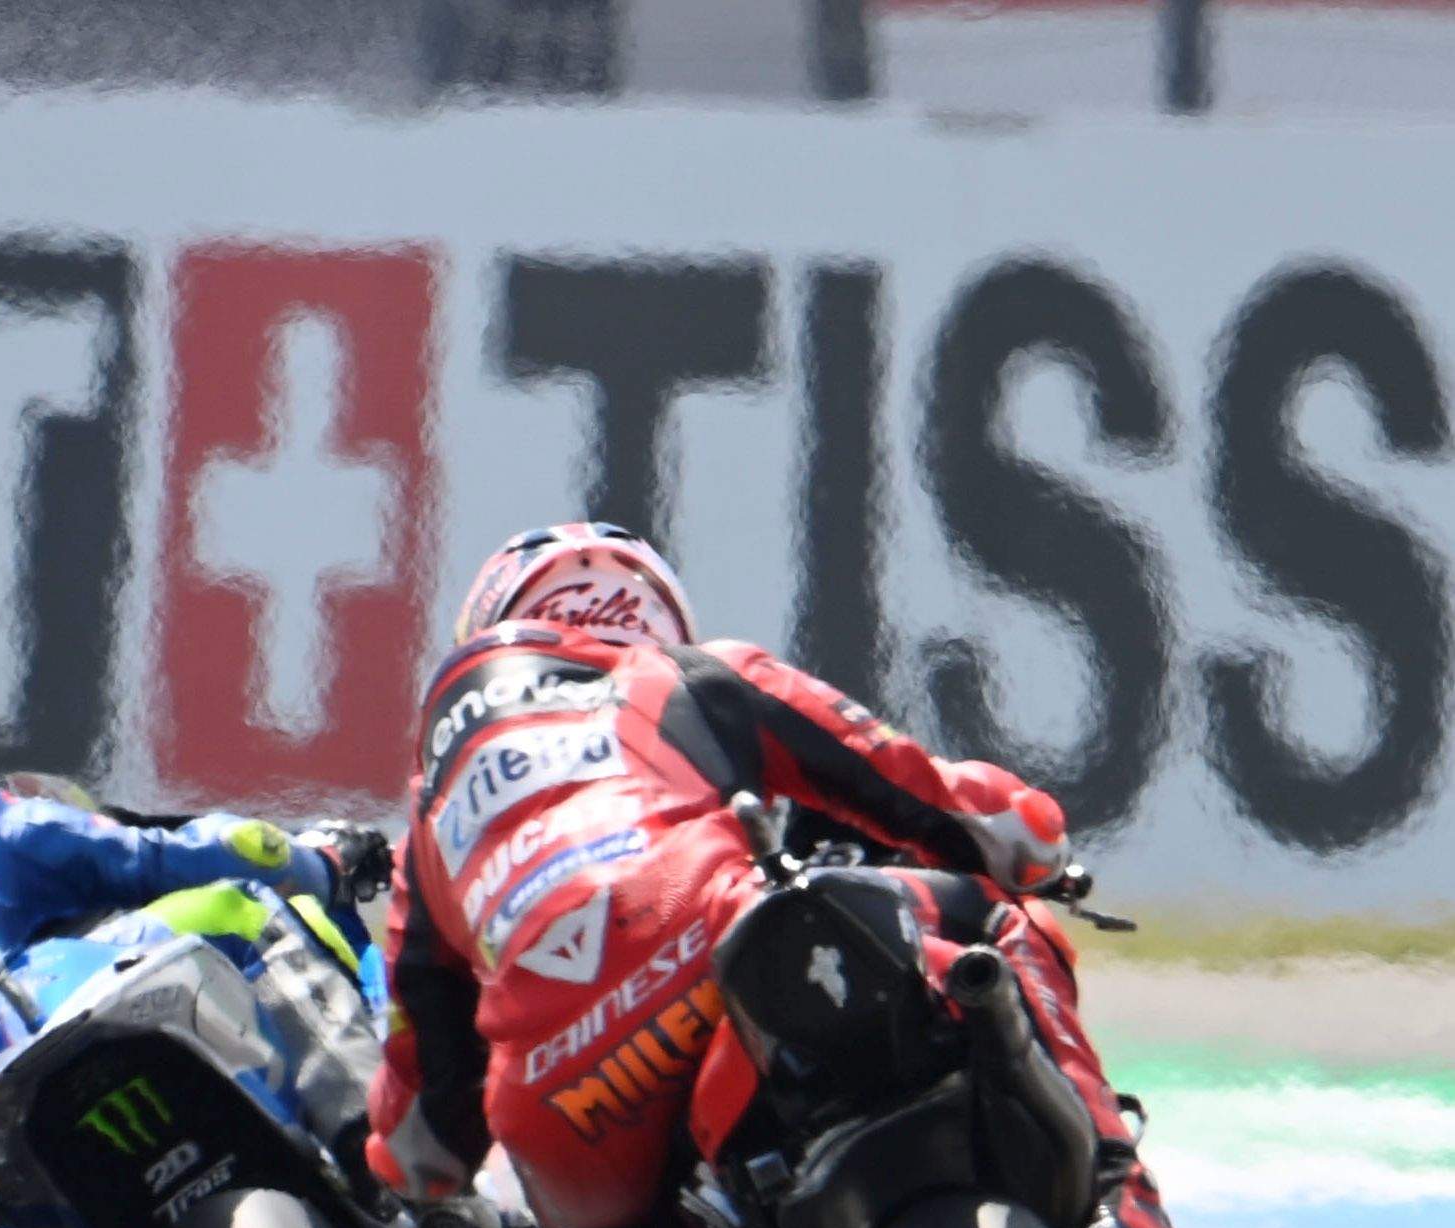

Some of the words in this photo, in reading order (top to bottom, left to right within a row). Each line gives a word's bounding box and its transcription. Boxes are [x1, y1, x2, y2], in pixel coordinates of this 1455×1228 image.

[492, 252, 1455, 855] TISS
[466, 730, 613, 814] rieo
[460, 785, 646, 934] DUC
[523, 917, 710, 1086] DAINESE
